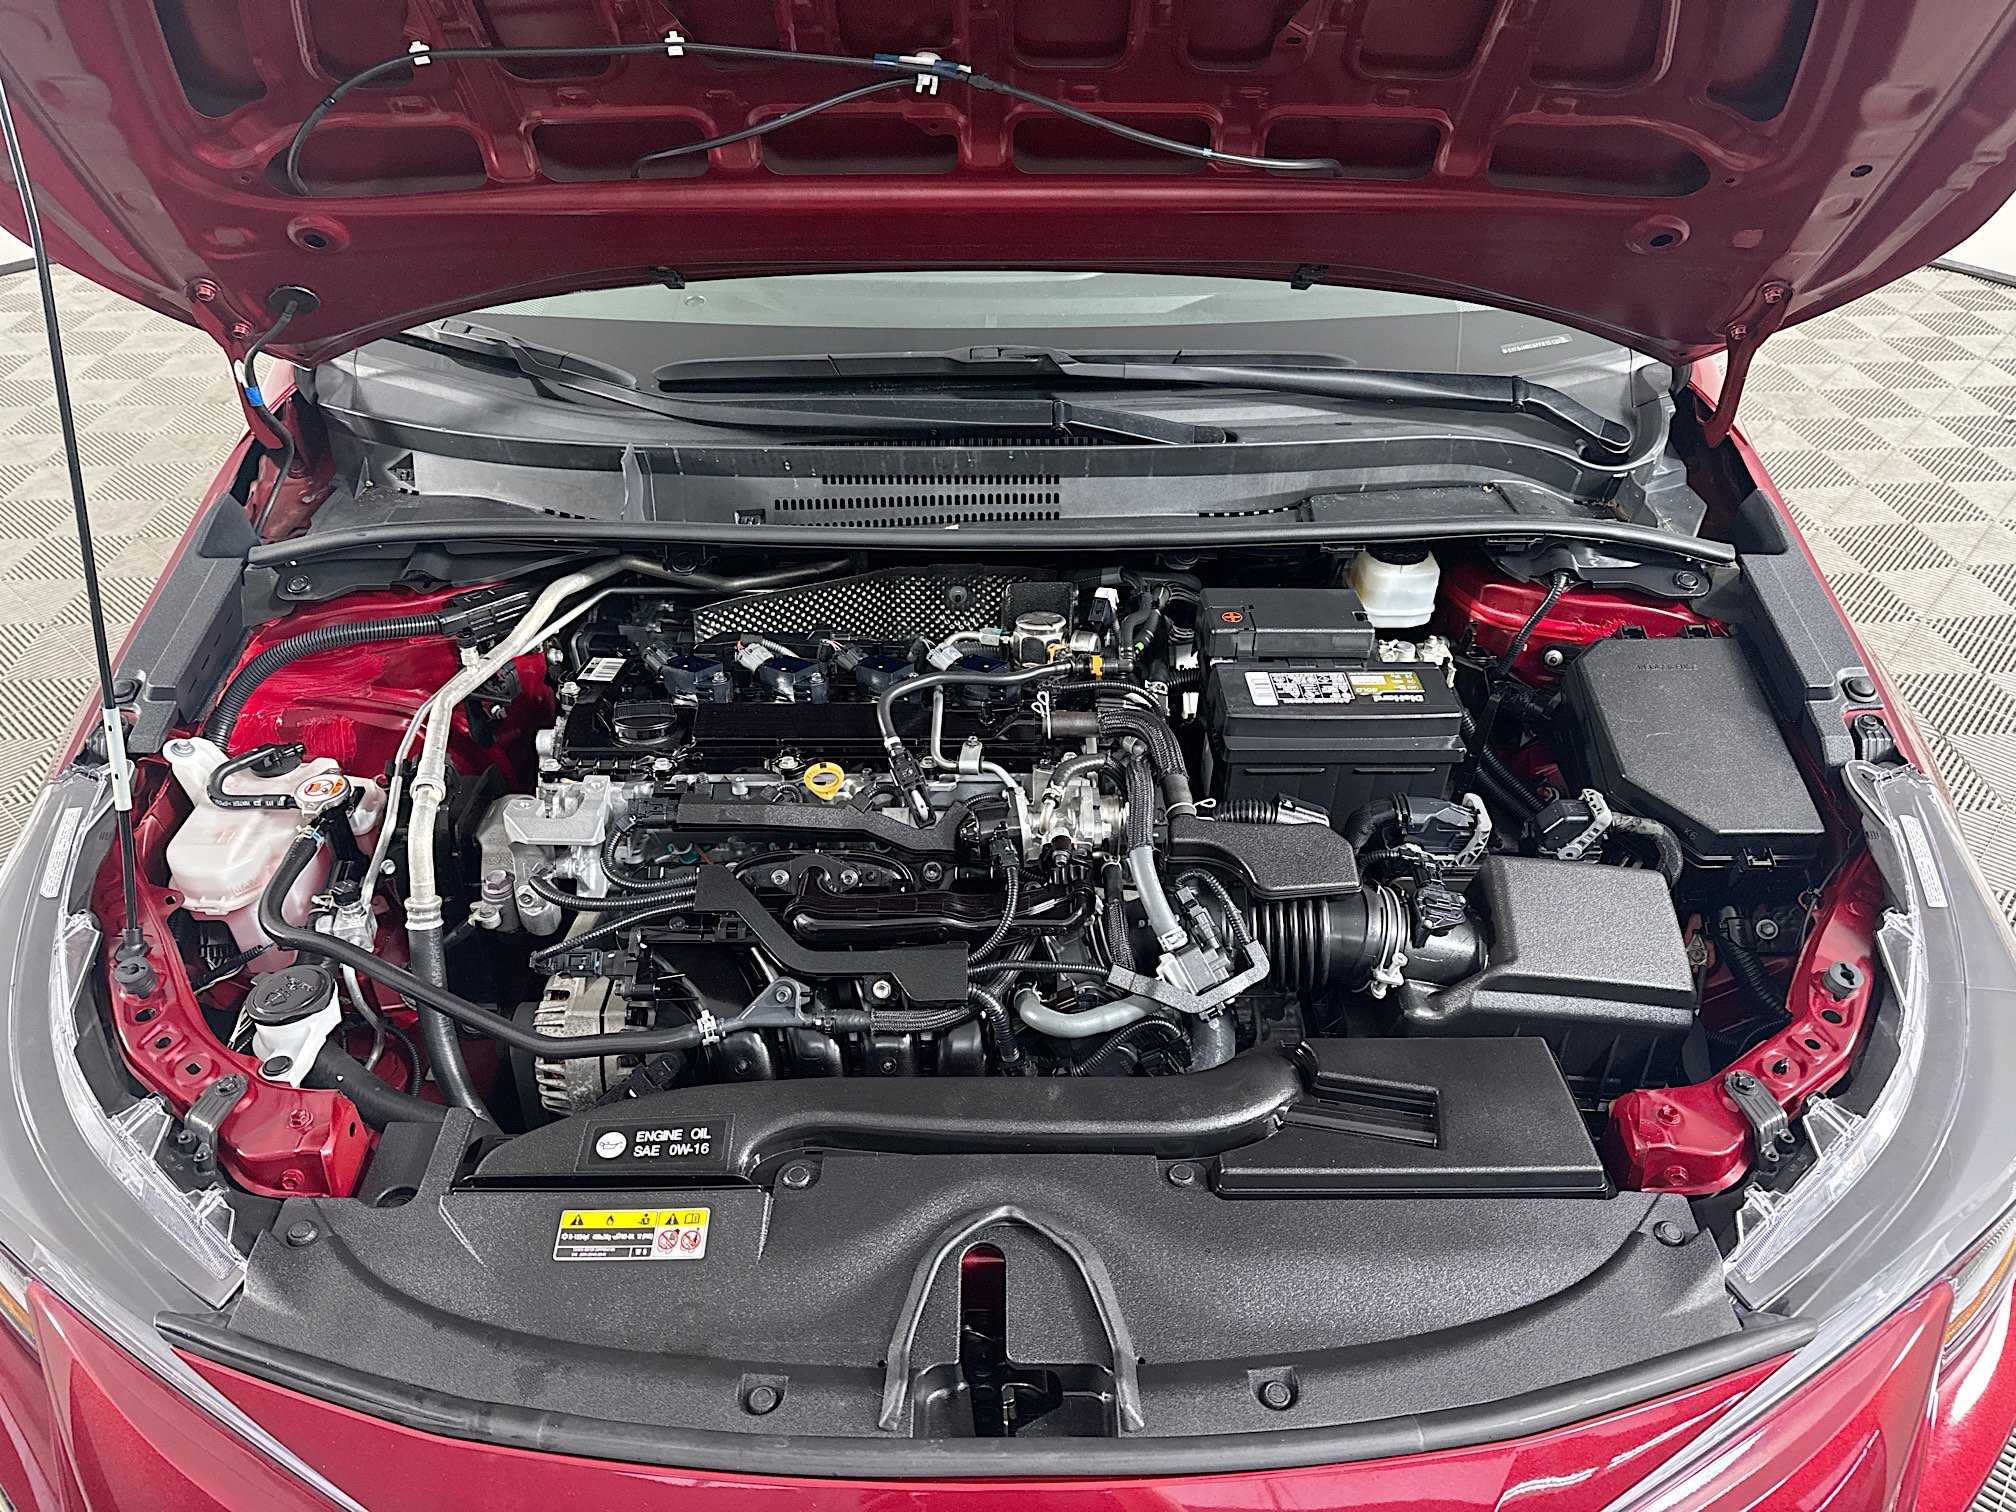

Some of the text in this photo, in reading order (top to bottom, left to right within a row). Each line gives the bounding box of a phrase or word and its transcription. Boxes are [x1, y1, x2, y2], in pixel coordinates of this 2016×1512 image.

[1373, 694, 1424, 703] DieHard
[635, 1127, 711, 1142] ENGINE OIL
[632, 1142, 710, 1157] SAE 0W-16
